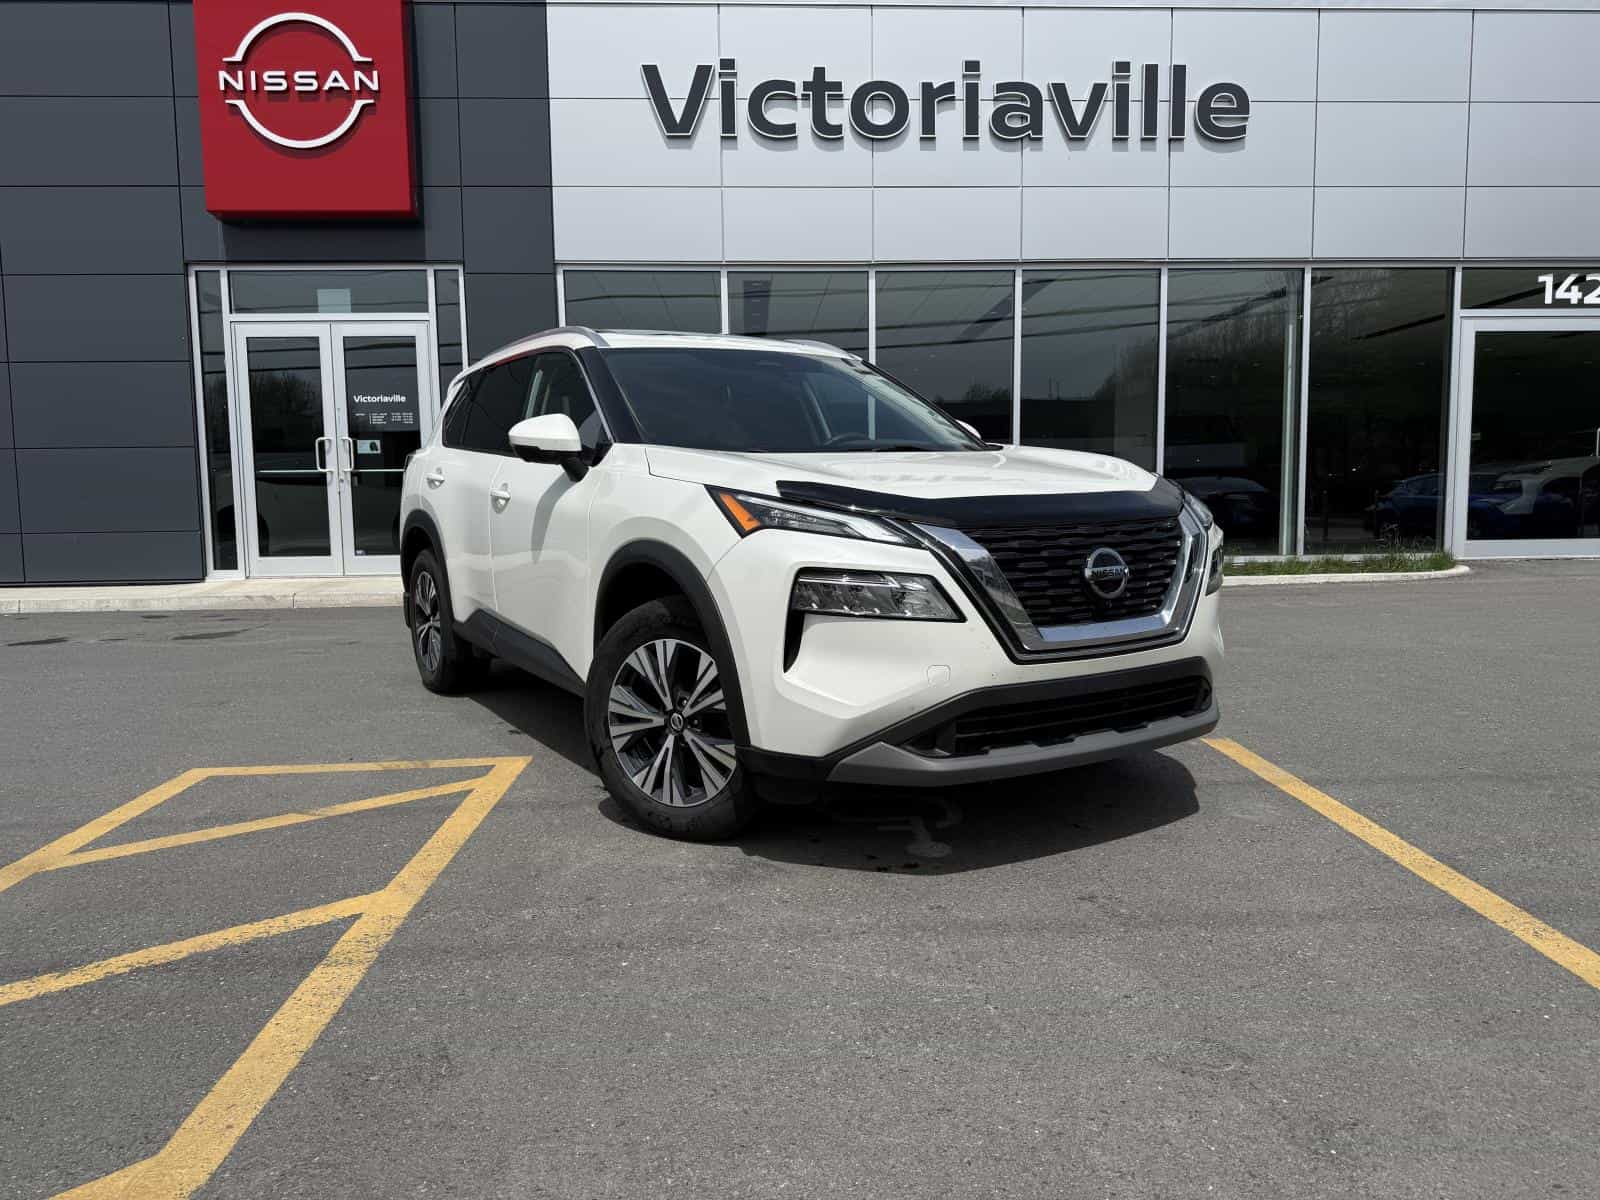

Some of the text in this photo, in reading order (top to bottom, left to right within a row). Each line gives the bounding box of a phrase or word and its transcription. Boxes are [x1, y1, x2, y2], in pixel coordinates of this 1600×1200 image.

[218, 70, 379, 91] NISSAN
[640, 58, 1250, 140] Victoriaville
[1537, 272, 1600, 305] 142
[353, 394, 407, 403] Victoriaville
[1090, 567, 1127, 578] NISSAN
